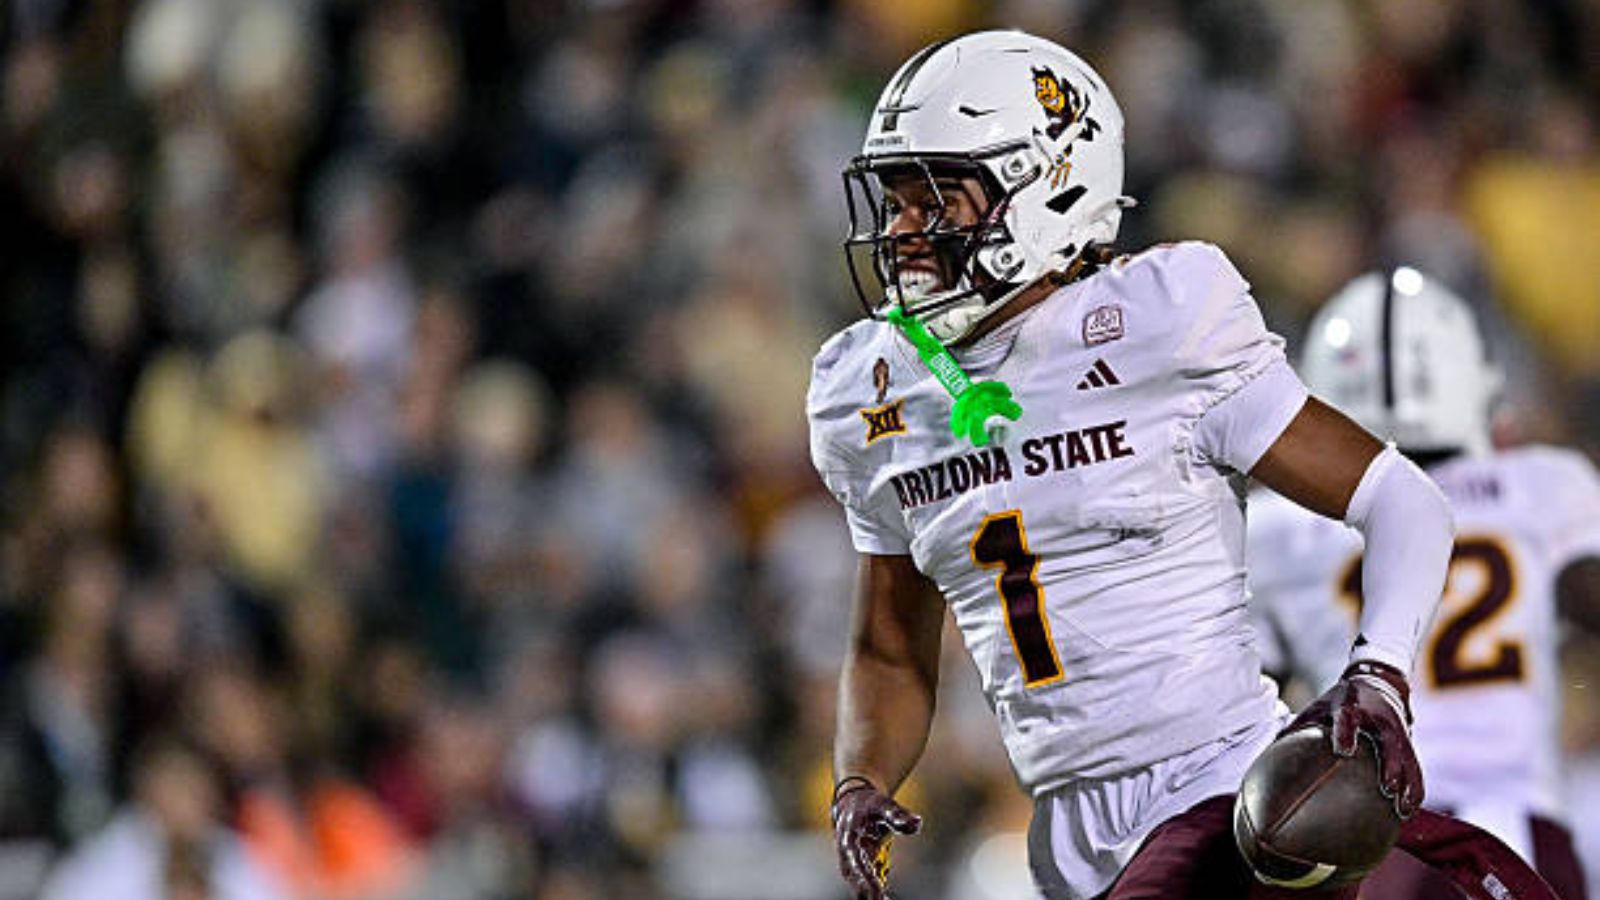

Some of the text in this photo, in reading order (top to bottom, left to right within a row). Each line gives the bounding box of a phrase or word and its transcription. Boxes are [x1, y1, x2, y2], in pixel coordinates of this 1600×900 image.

[889, 420, 1135, 510] ARIZONA STATE
[970, 509, 1065, 688] 1
